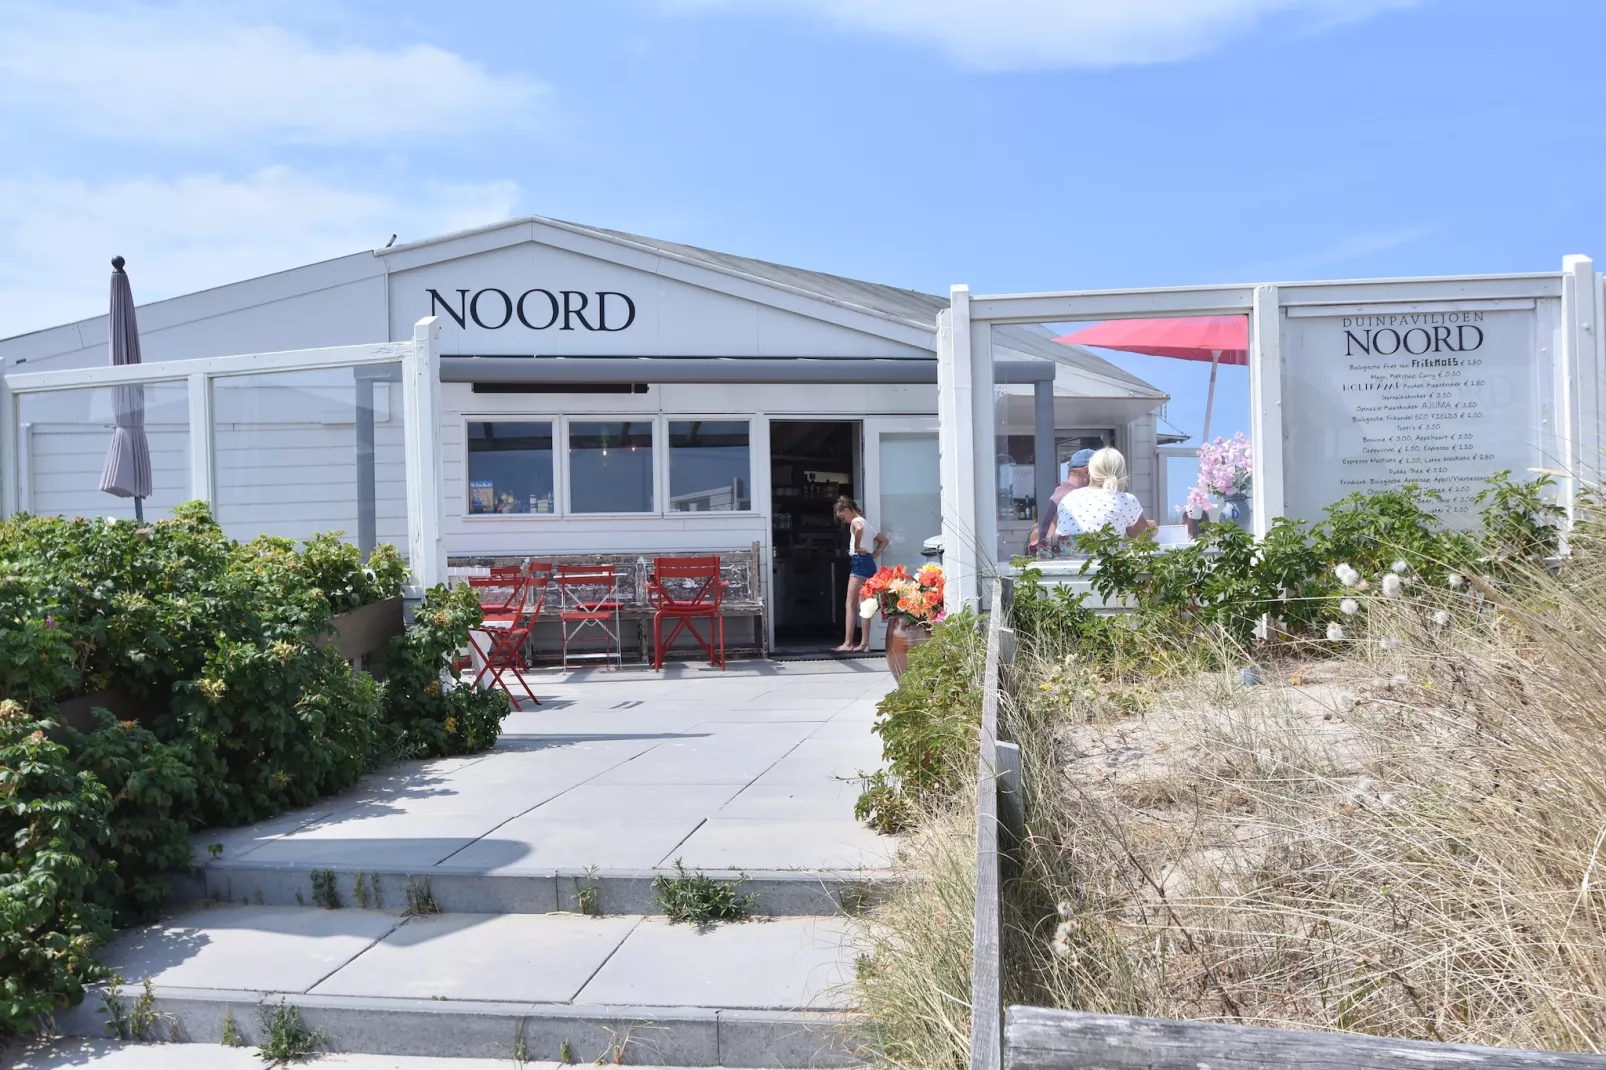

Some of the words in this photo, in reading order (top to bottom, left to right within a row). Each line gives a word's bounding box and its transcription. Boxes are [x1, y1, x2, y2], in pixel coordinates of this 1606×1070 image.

[425, 288, 636, 331] NOORD
[1343, 312, 1484, 327] DUINPAVILJOEN
[1343, 325, 1484, 356] NOORD
[1419, 372, 1436, 380] Curry
[1342, 382, 1402, 391] HOLTKAMP
[1422, 401, 1451, 409] AJUMA
[1342, 458, 1368, 466] Espresso
[1370, 478, 1401, 486] Biologische
